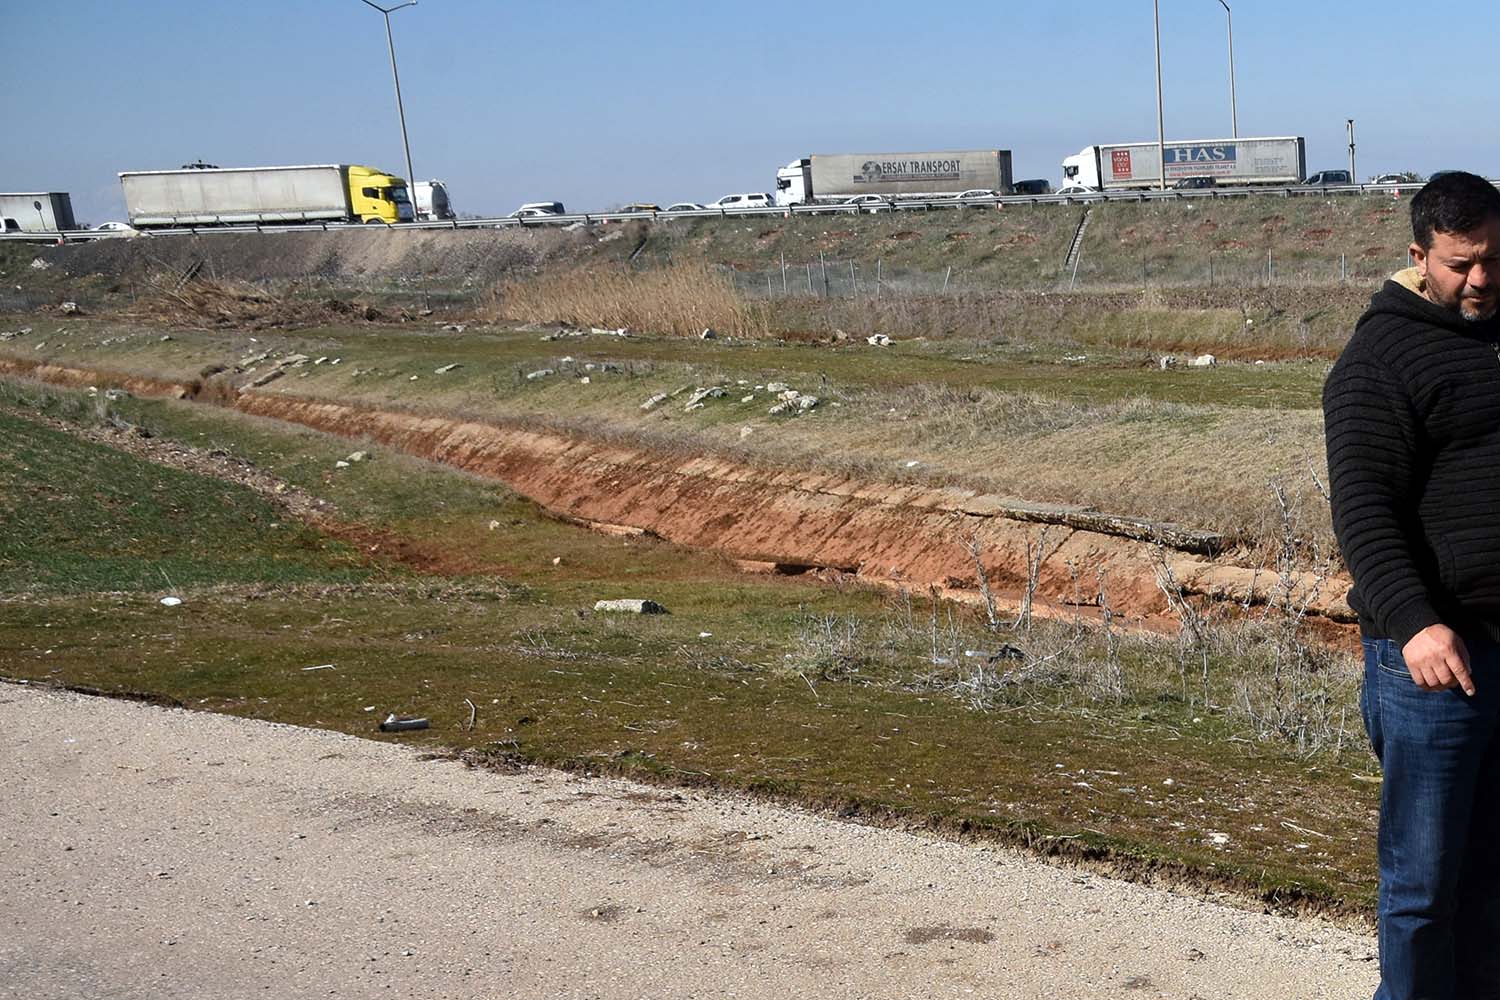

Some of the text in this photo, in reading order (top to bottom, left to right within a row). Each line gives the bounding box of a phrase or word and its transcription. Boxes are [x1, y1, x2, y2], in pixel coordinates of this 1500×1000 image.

[1174, 147, 1226, 162] HAS
[882, 160, 961, 174] ERSAY TRANSPORT
